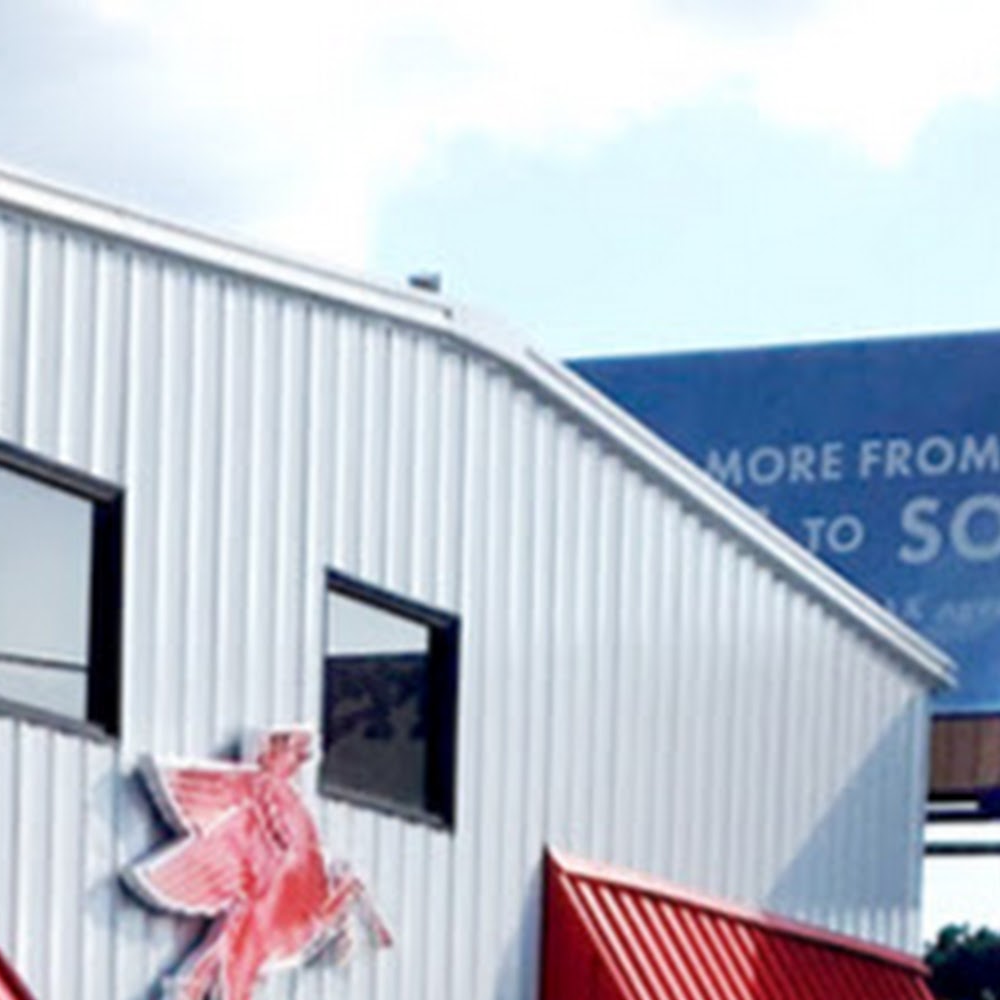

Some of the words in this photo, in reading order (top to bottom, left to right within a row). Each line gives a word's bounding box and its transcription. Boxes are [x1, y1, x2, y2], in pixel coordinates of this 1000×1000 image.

[705, 443, 842, 486] MORE
[860, 435, 1000, 477] FROM
[803, 515, 864, 553] TO
[899, 495, 1000, 564] SO
